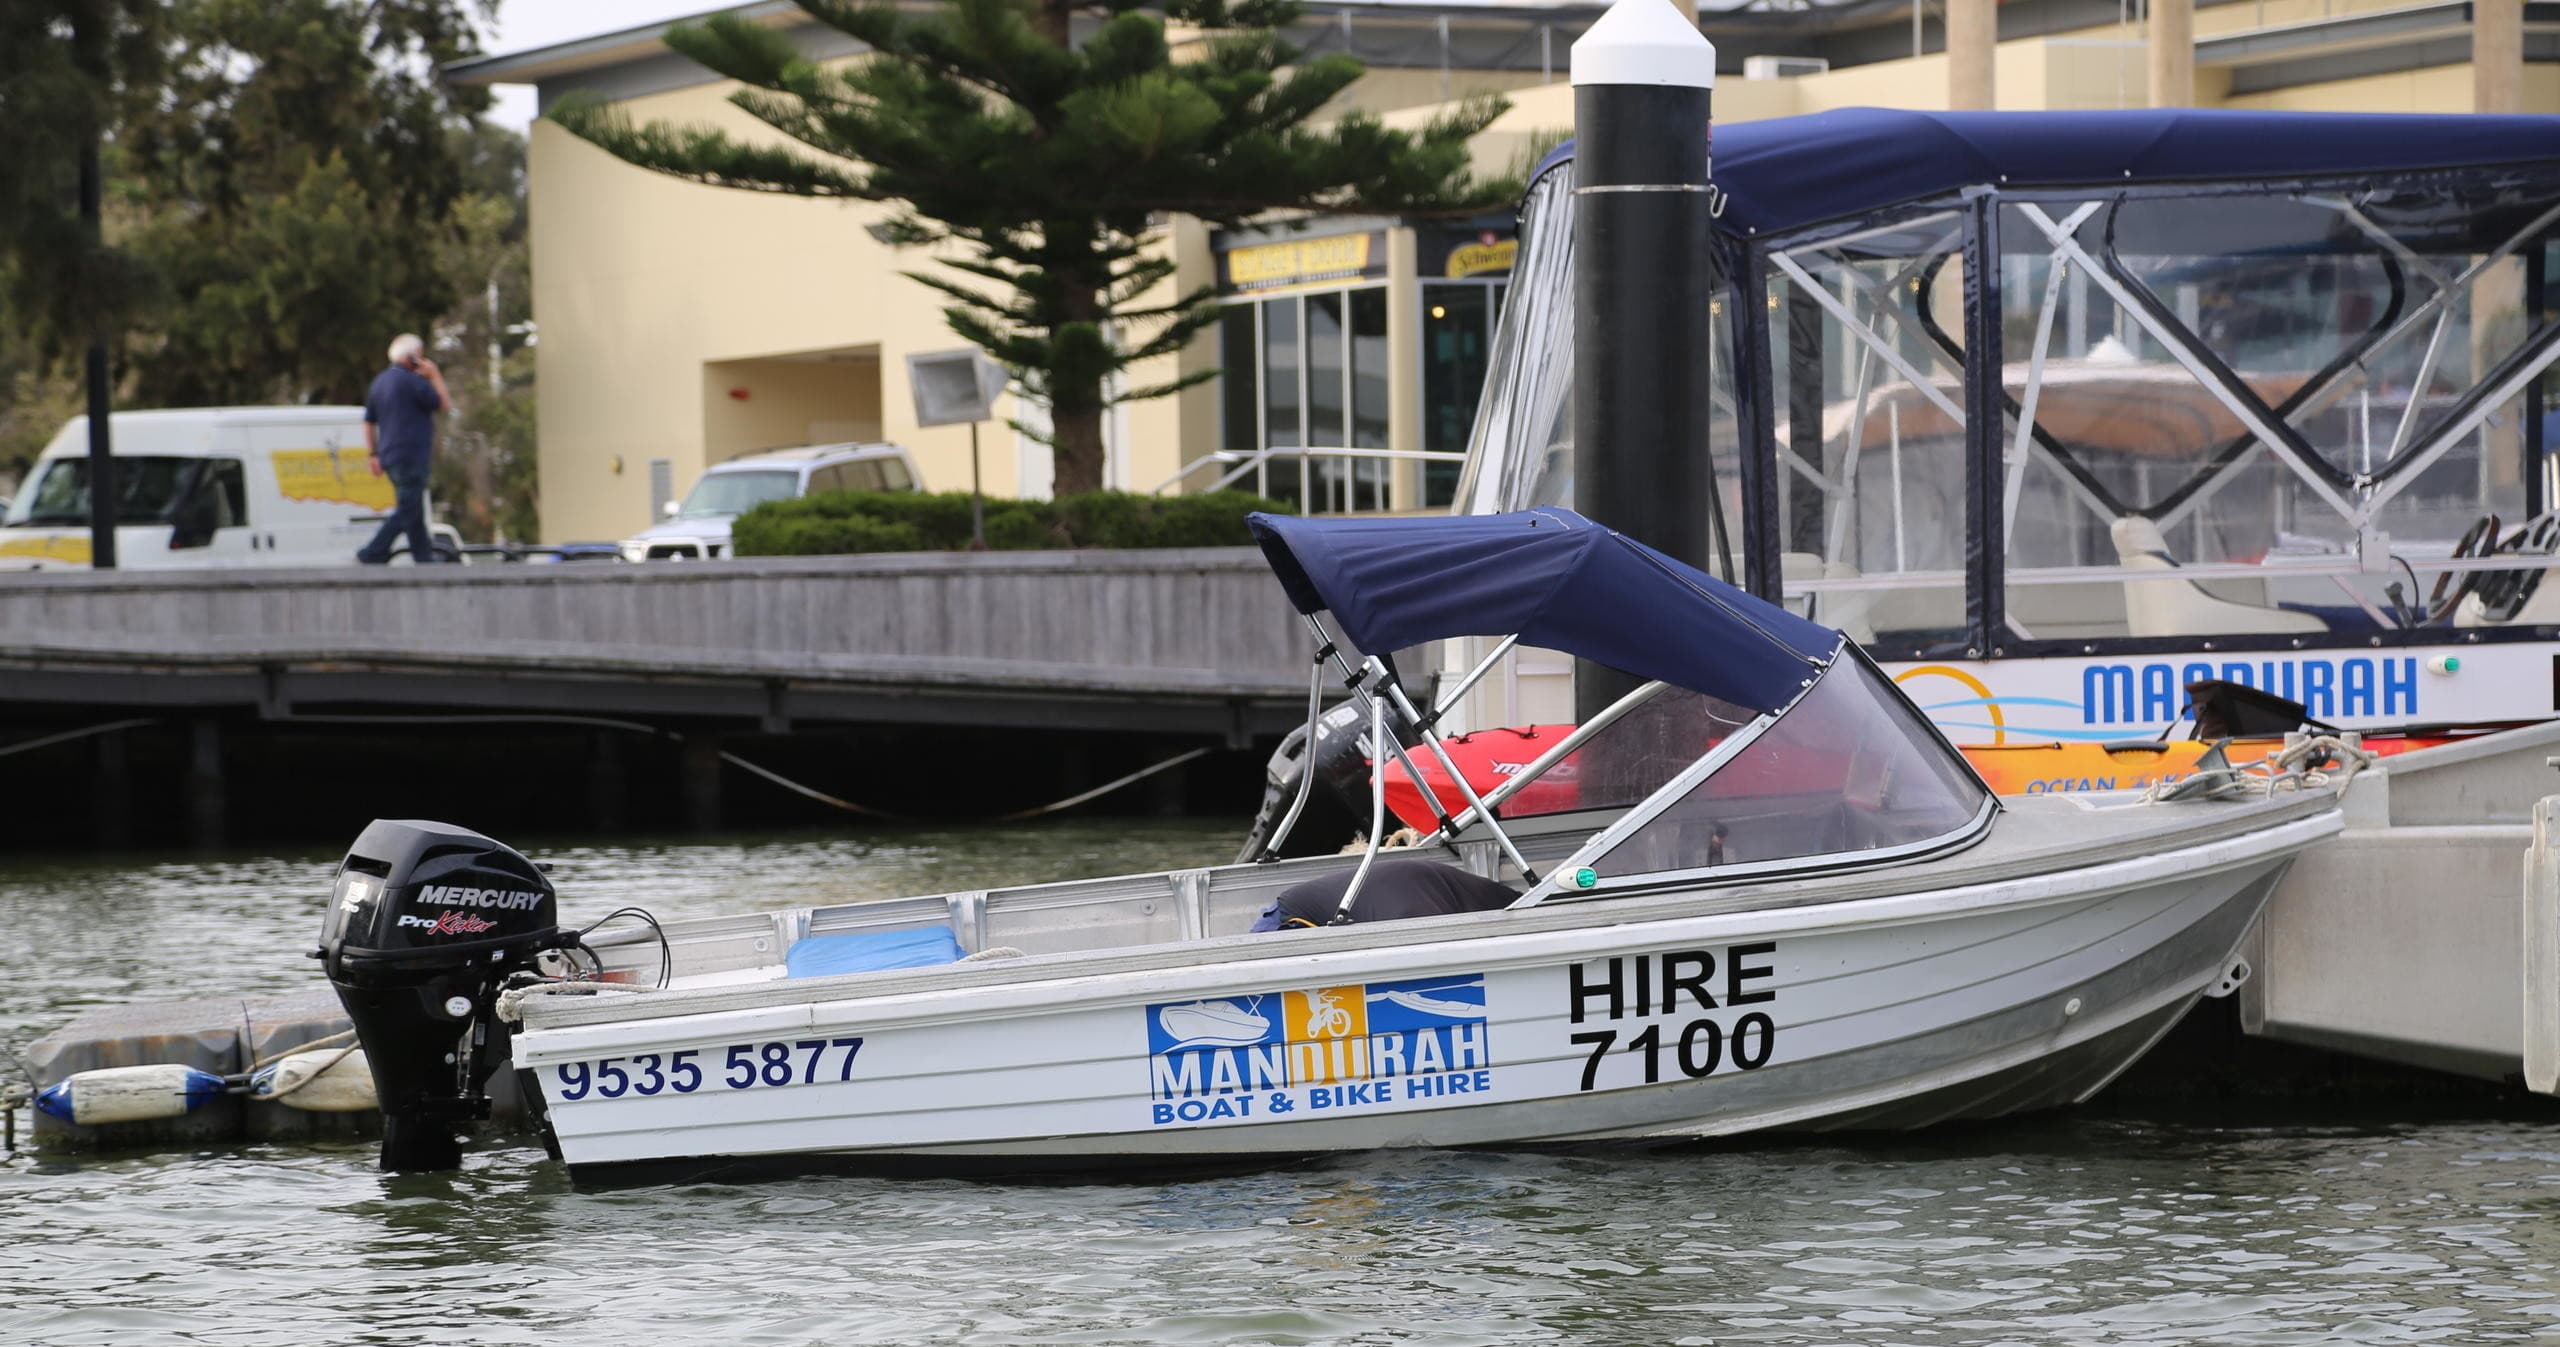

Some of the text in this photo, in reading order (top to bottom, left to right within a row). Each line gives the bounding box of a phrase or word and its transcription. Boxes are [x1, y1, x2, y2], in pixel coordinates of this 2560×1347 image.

[2027, 776, 2116, 794] OCEAN
[416, 885, 544, 911] MERCURY
[1569, 941, 1776, 1024] HIRE
[558, 1037, 864, 1101] 9535 5877
[1151, 1021, 1490, 1101] MANDURAH
[1569, 1012, 1776, 1092] 7100
[1153, 1070, 1491, 1125] BOAT & BIKE HIRE
